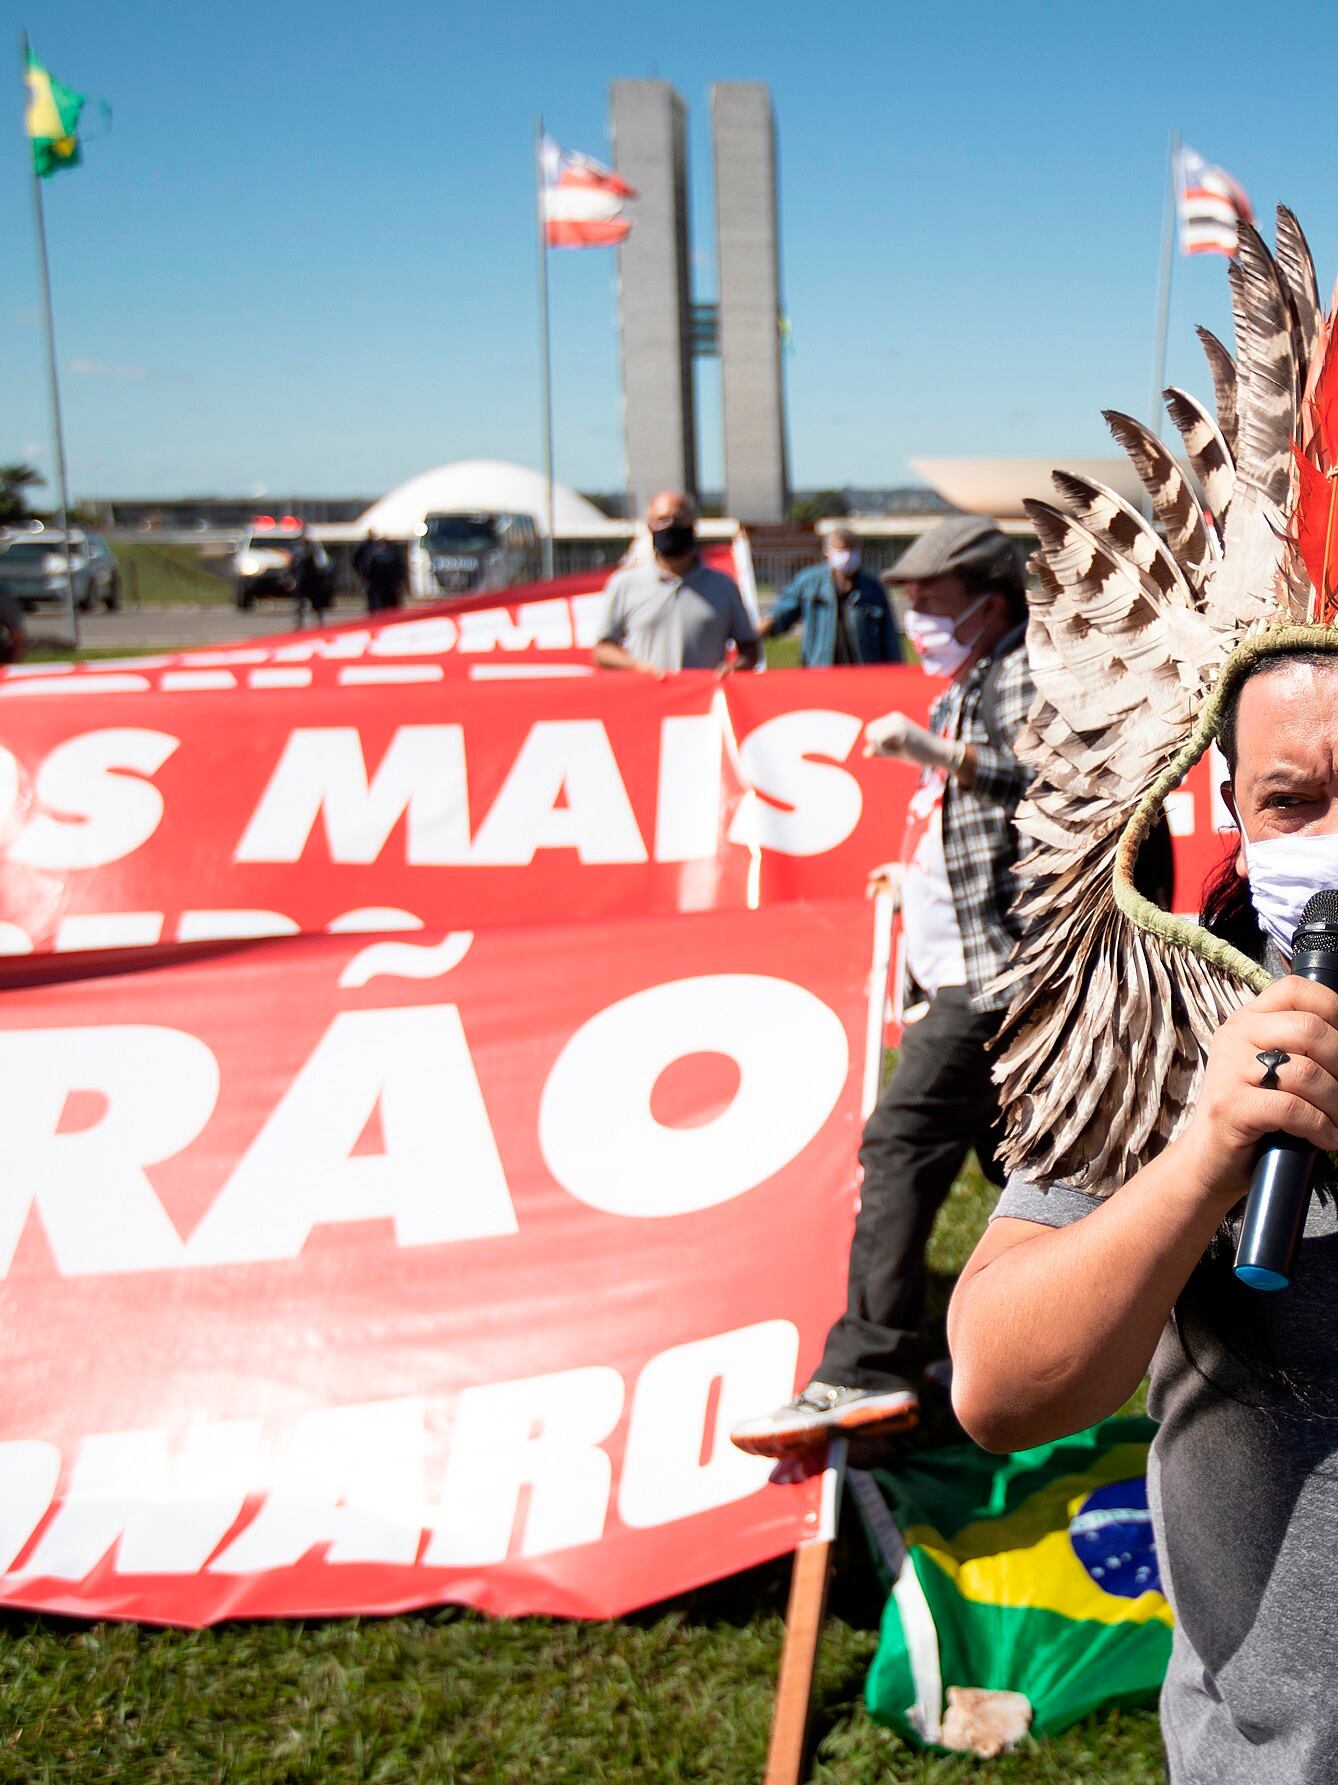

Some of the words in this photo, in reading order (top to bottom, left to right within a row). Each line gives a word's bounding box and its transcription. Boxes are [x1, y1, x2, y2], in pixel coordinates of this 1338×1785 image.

[0, 727, 181, 870] S
[236, 709, 864, 866] MAIS
[0, 931, 850, 1279] RÃO
